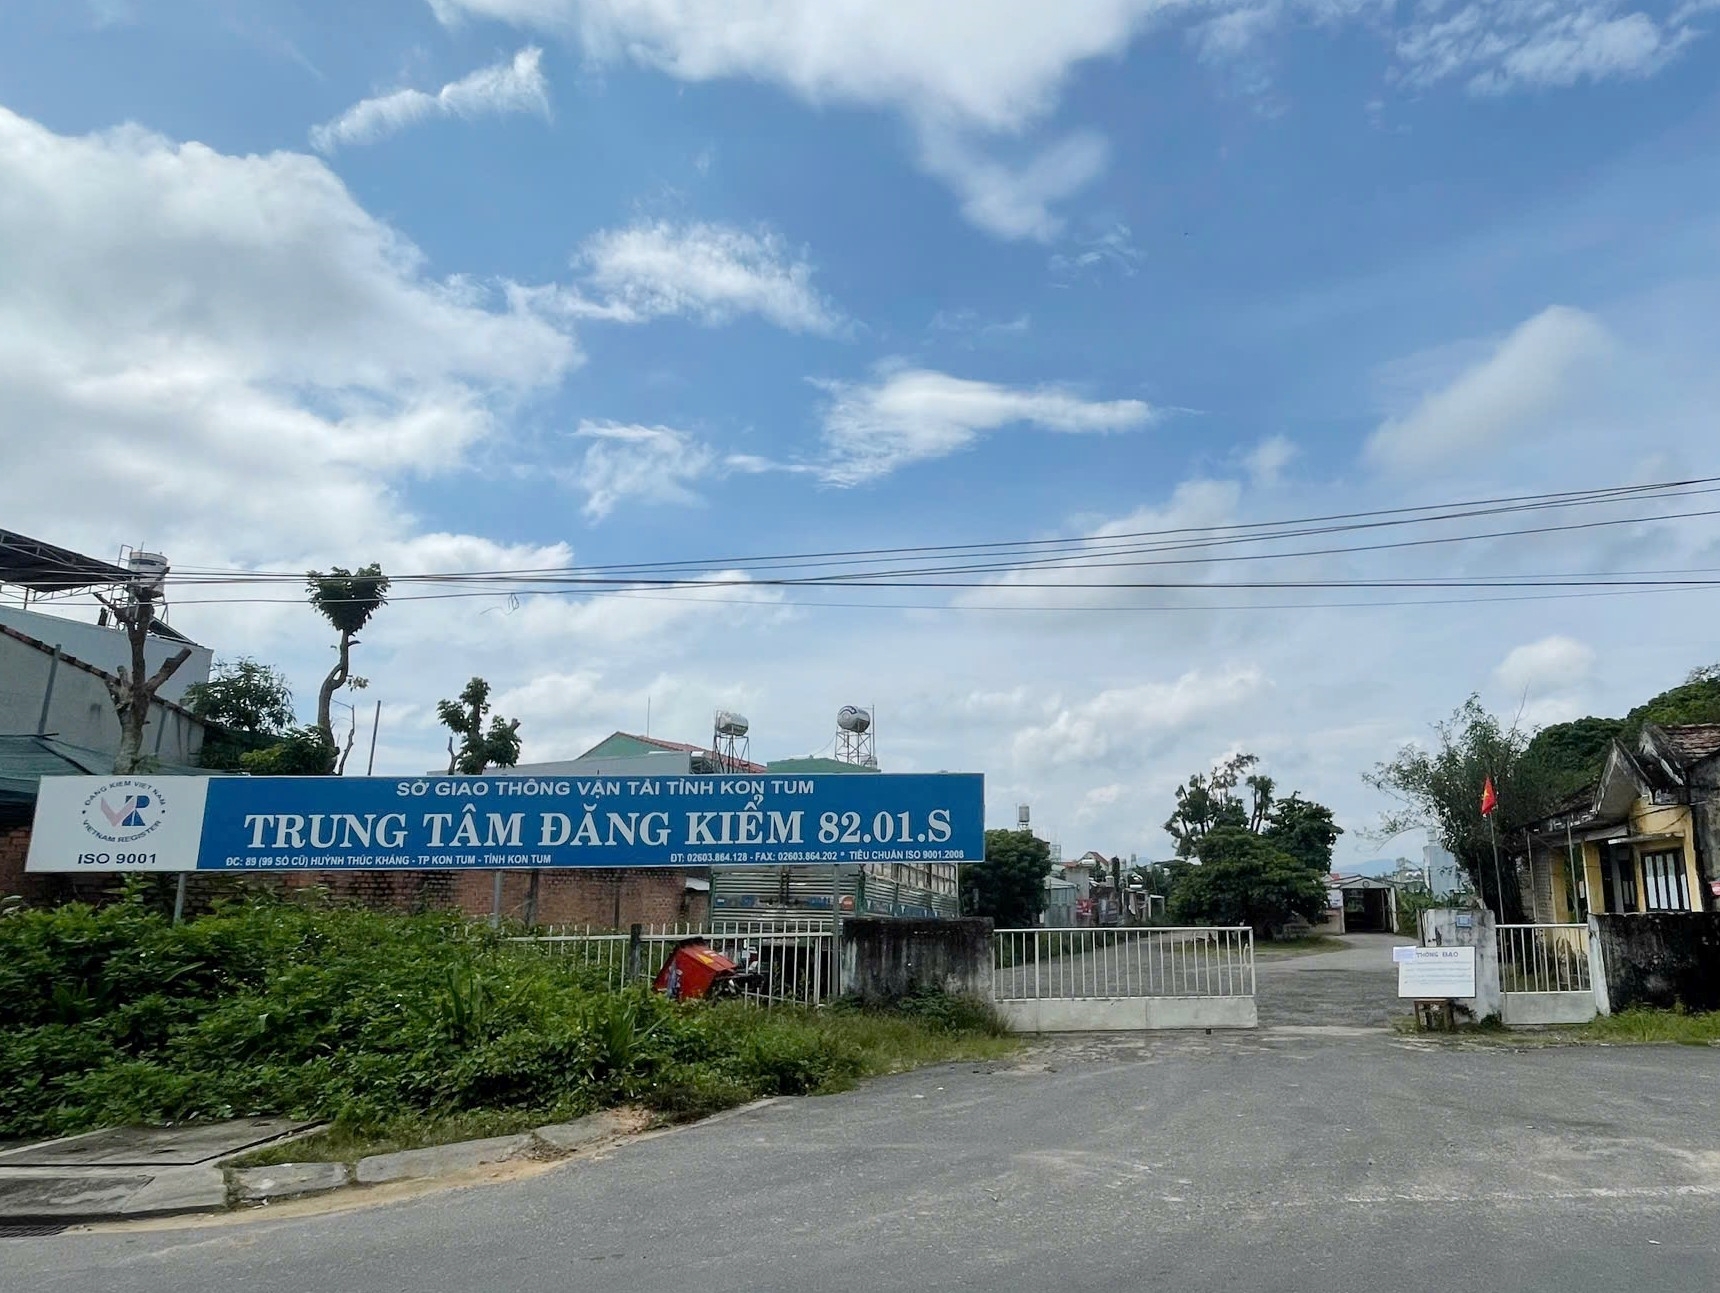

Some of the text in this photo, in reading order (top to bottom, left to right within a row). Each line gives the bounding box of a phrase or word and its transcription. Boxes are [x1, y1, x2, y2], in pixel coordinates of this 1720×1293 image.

[396, 778, 814, 799] SỞ GIAO THÔNG VẬN TẢI TỈNH KON TUM
[243, 794, 952, 848] TRUNG TÂM ĐĂNG KIỂM 82.01.S
[83, 819, 162, 843] VIETNAM REGISTER
[77, 853, 157, 864] ISO 9001
[225, 856, 243, 866] ĐC:
[245, 856, 257, 866] 89
[258, 857, 273, 868] (99
[292, 854, 309, 868] CŨ)
[347, 853, 373, 866] THÚC
[375, 853, 410, 865] KHÁNG
[417, 856, 430, 865] TP
[431, 855, 453, 865] KON
[455, 855, 476, 865] TUM
[507, 854, 529, 864] KON
[531, 854, 552, 864] TUM
[670, 853, 685, 863] ĐT:
[687, 852, 747, 862] 02603.864.128
[755, 851, 776, 861] FAX:
[778, 851, 837, 861] 02603.864.202
[850, 849, 869, 861] TIÊU
[905, 850, 921, 860] ISO
